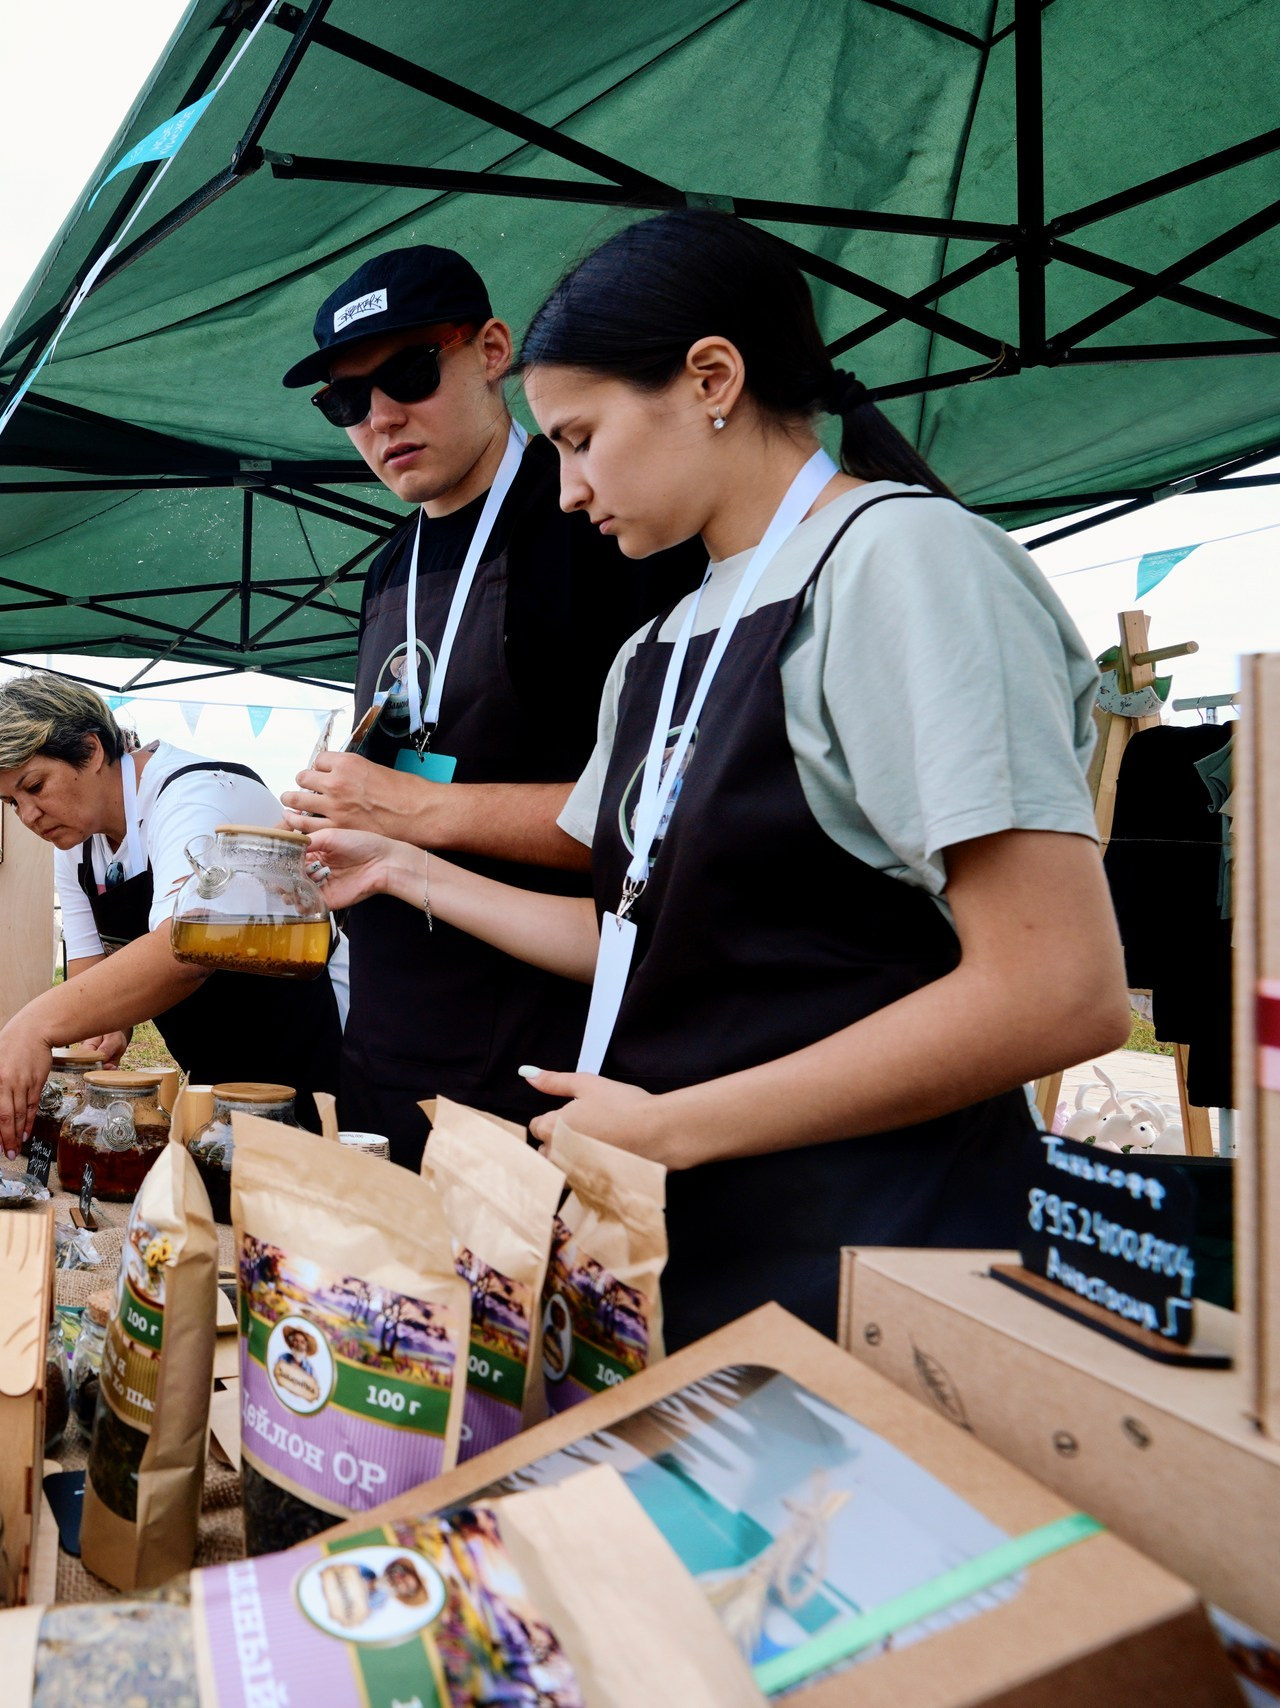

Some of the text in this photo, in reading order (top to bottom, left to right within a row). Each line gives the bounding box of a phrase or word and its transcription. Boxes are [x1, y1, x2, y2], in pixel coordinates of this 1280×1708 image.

[127, 1307, 159, 1336] 100 г
[467, 1355, 504, 1383] 00 г
[595, 1362, 624, 1387] 100
[366, 1385, 423, 1416] 100 г
